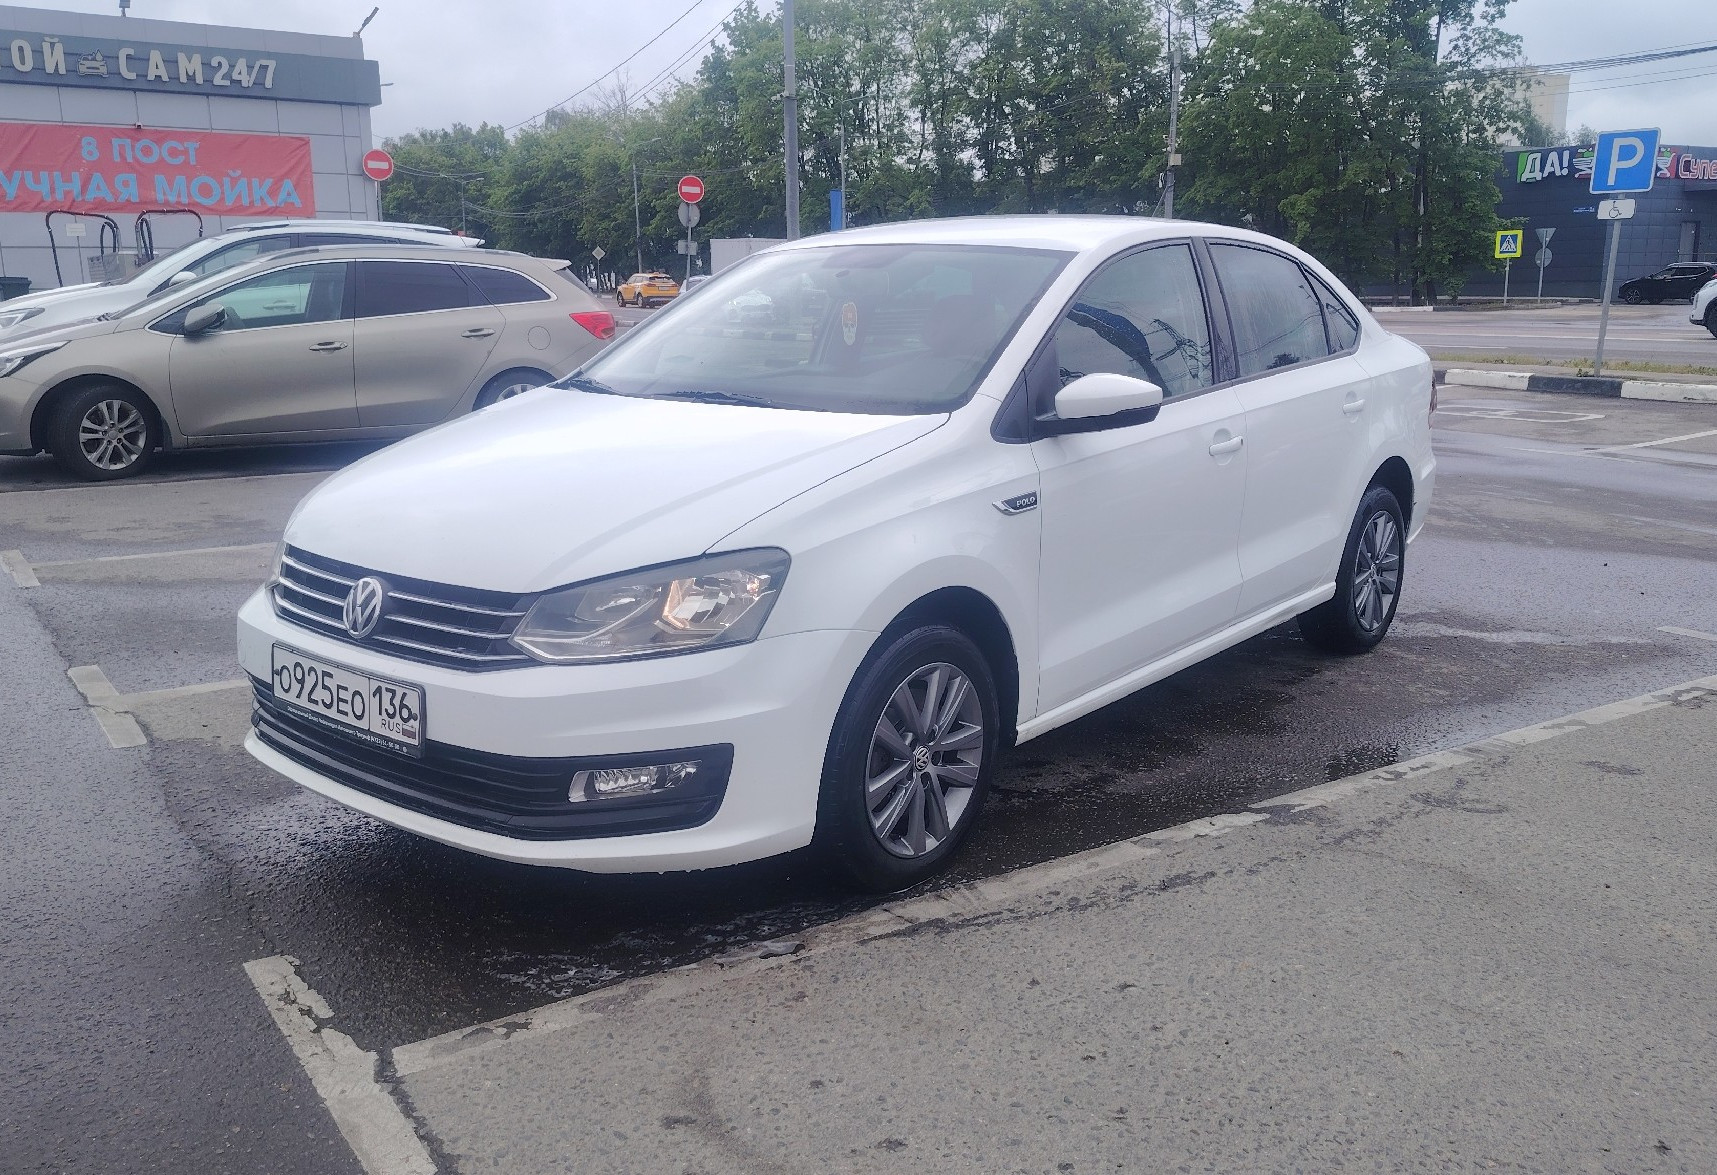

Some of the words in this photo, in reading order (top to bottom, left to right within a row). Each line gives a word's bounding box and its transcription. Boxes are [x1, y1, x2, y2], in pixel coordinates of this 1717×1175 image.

[0, 36, 67, 75] ОЙ
[118, 48, 203, 84] САМ
[210, 56, 277, 89] 24/7
[112, 138, 199, 165] ПОСТ
[1520, 150, 1570, 183] ДА!
[1607, 137, 1645, 186] P
[156, 169, 303, 208] МОЙКА
[1016, 496, 1036, 508] POLO
[372, 685, 413, 724] 136
[380, 718, 401, 734] RUS
